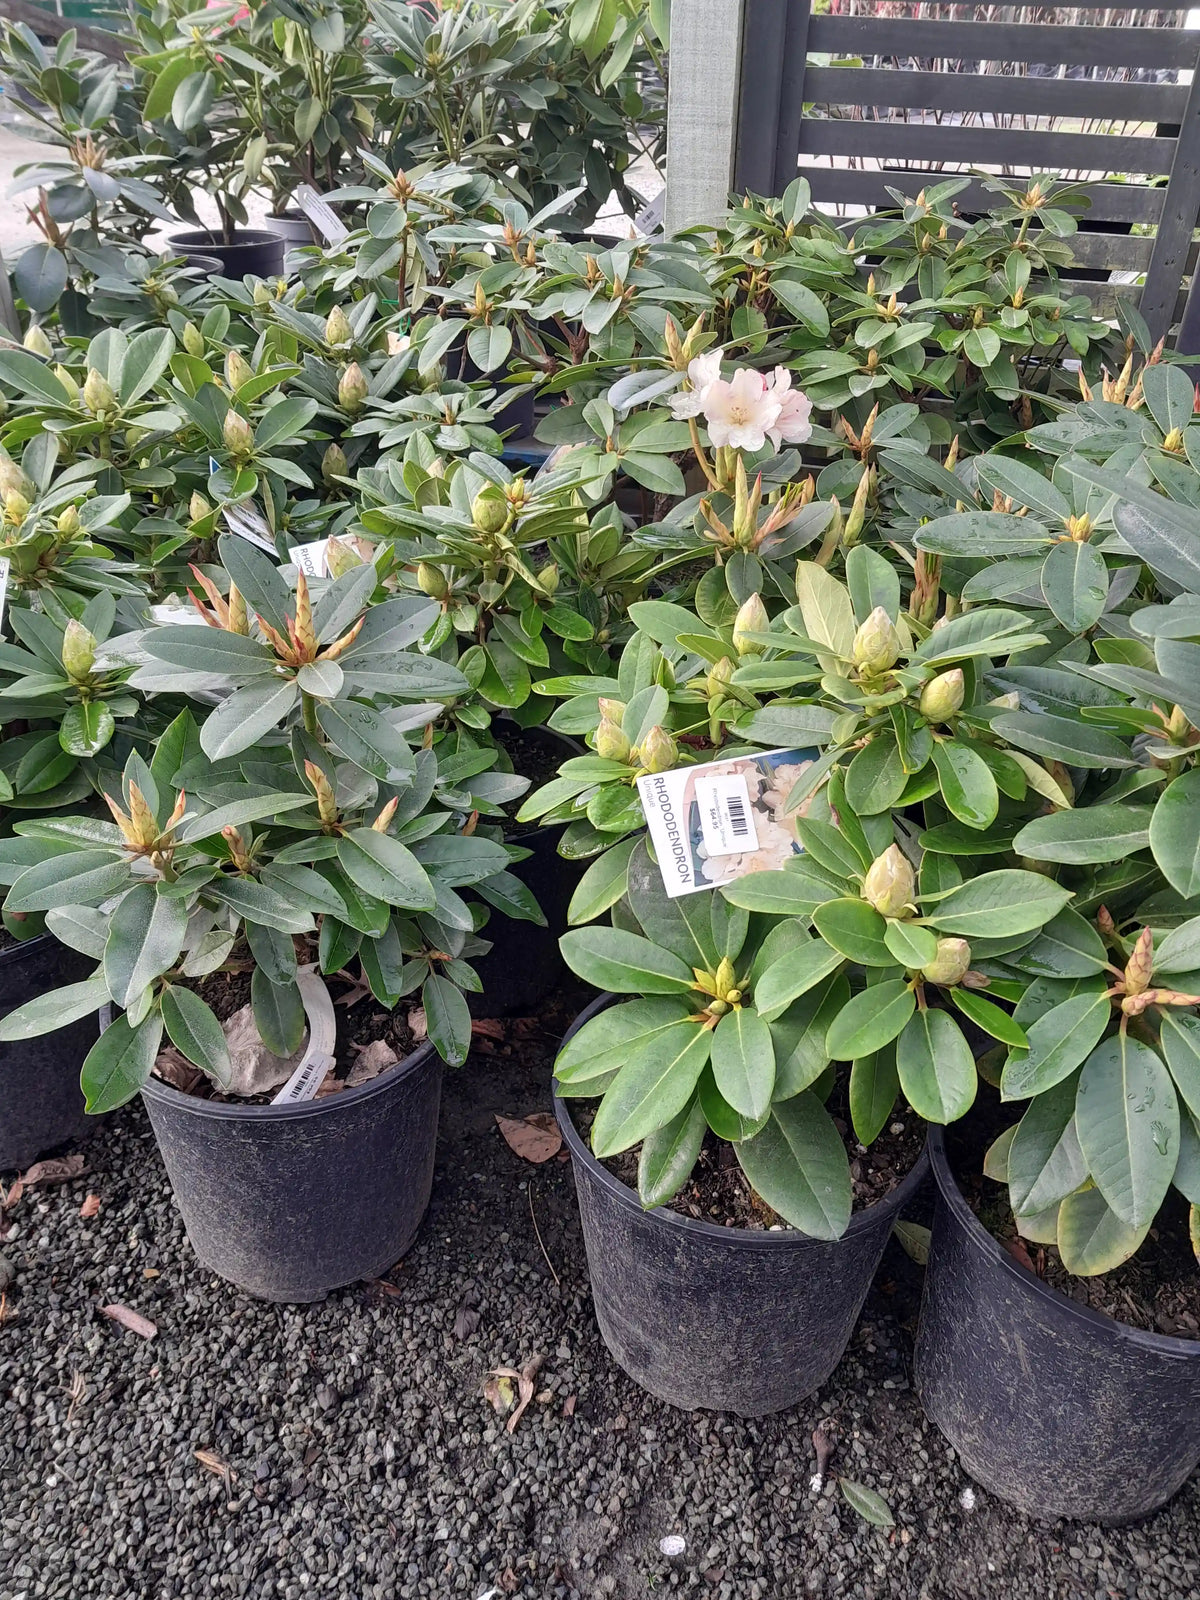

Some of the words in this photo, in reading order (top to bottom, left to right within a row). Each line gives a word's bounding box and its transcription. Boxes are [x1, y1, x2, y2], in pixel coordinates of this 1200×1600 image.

[643, 779, 656, 808] Unique
[653, 777, 691, 883] RHODODENDRON
[710, 808, 719, 830] $64.95
